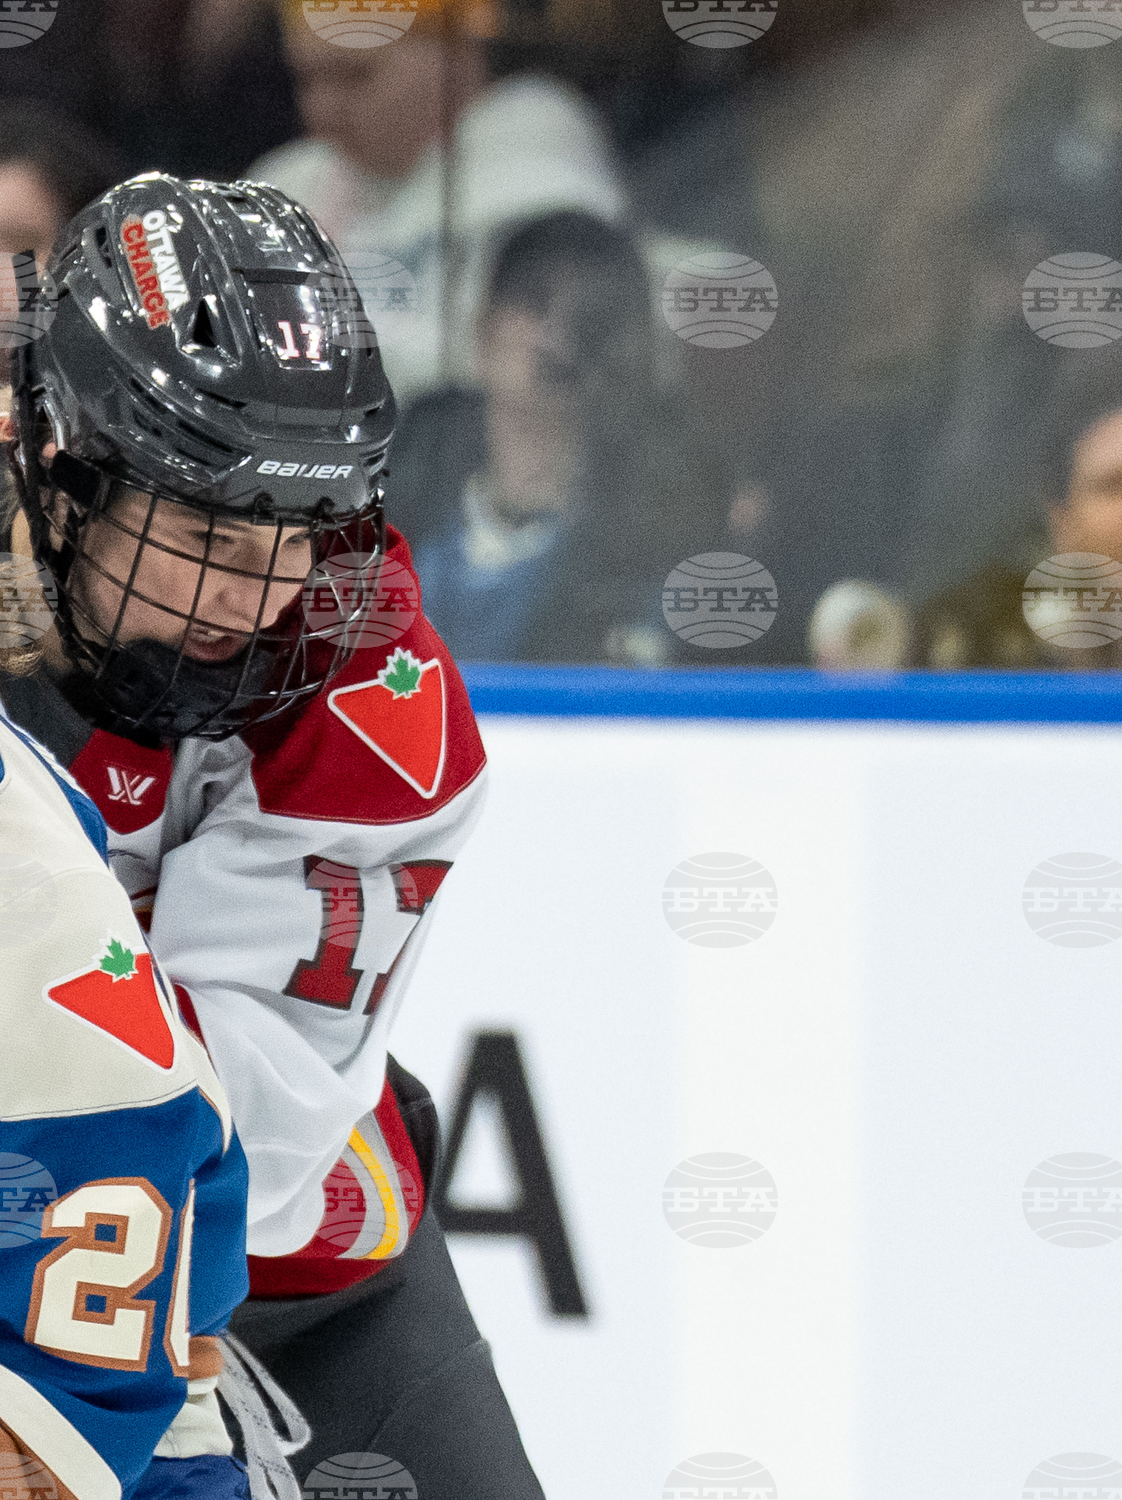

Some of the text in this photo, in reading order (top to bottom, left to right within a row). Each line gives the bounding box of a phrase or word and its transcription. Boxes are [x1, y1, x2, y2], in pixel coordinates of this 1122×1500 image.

[122, 223, 170, 328] CHARGE
[142, 210, 190, 312] OTTAWA
[277, 320, 323, 361] 17
